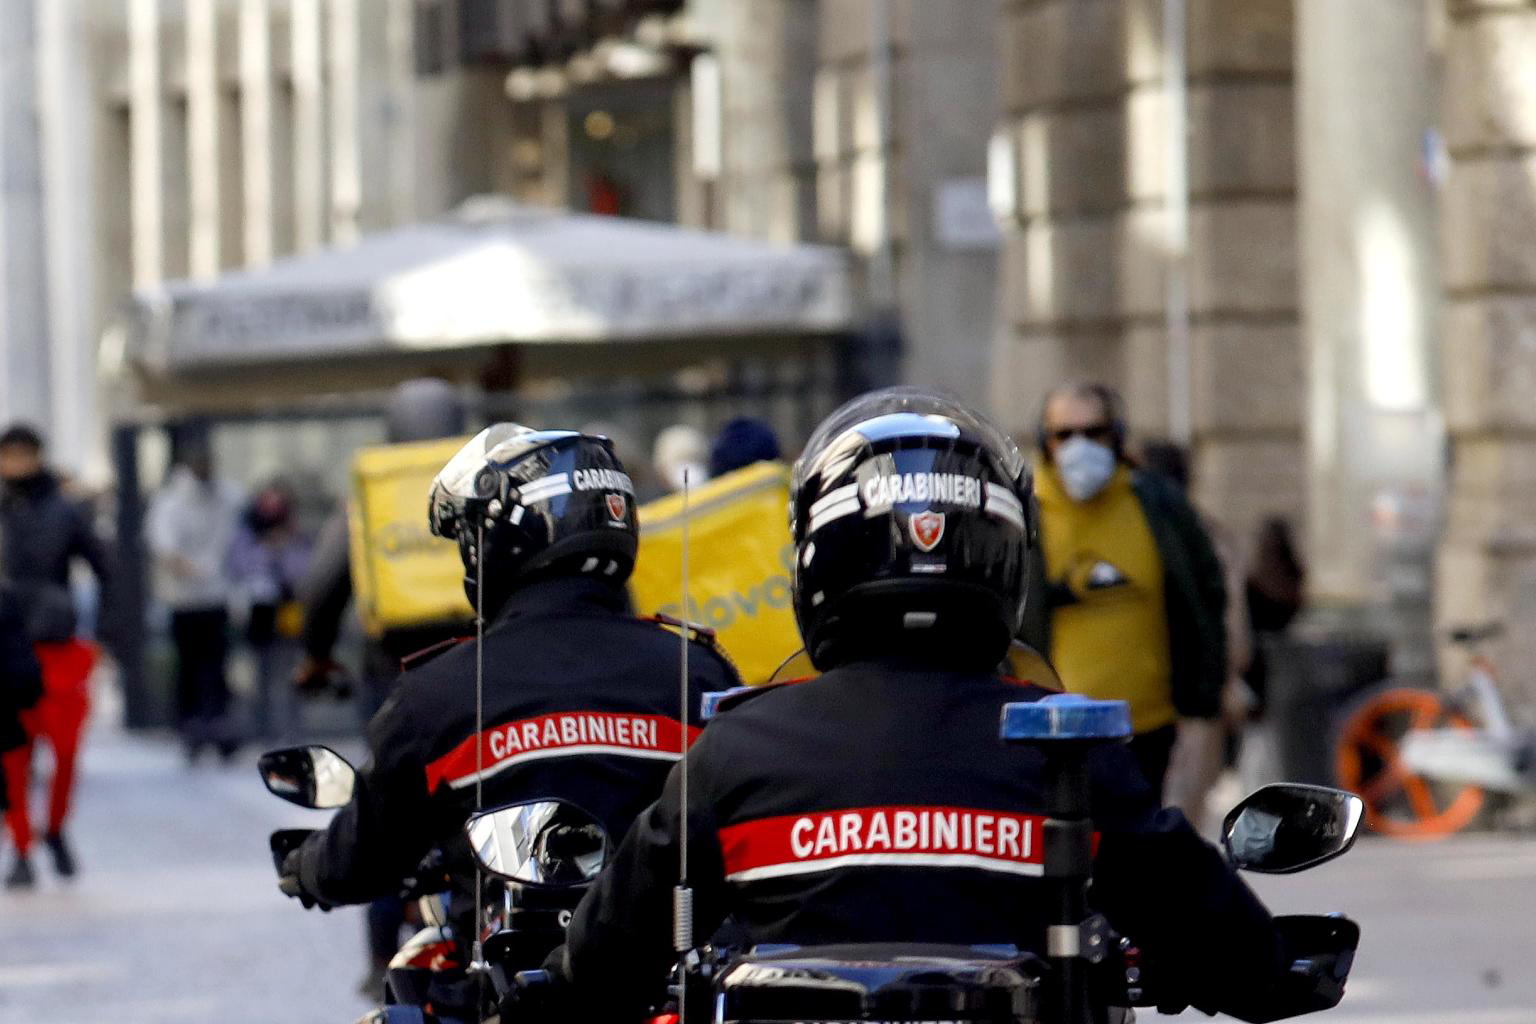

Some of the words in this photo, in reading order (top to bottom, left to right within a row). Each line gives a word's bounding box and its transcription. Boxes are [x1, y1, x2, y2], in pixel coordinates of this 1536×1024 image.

[864, 472, 981, 507] CARABINIERI
[489, 715, 658, 759] CARABINIERI
[790, 811, 1032, 858] CARABINIERI
